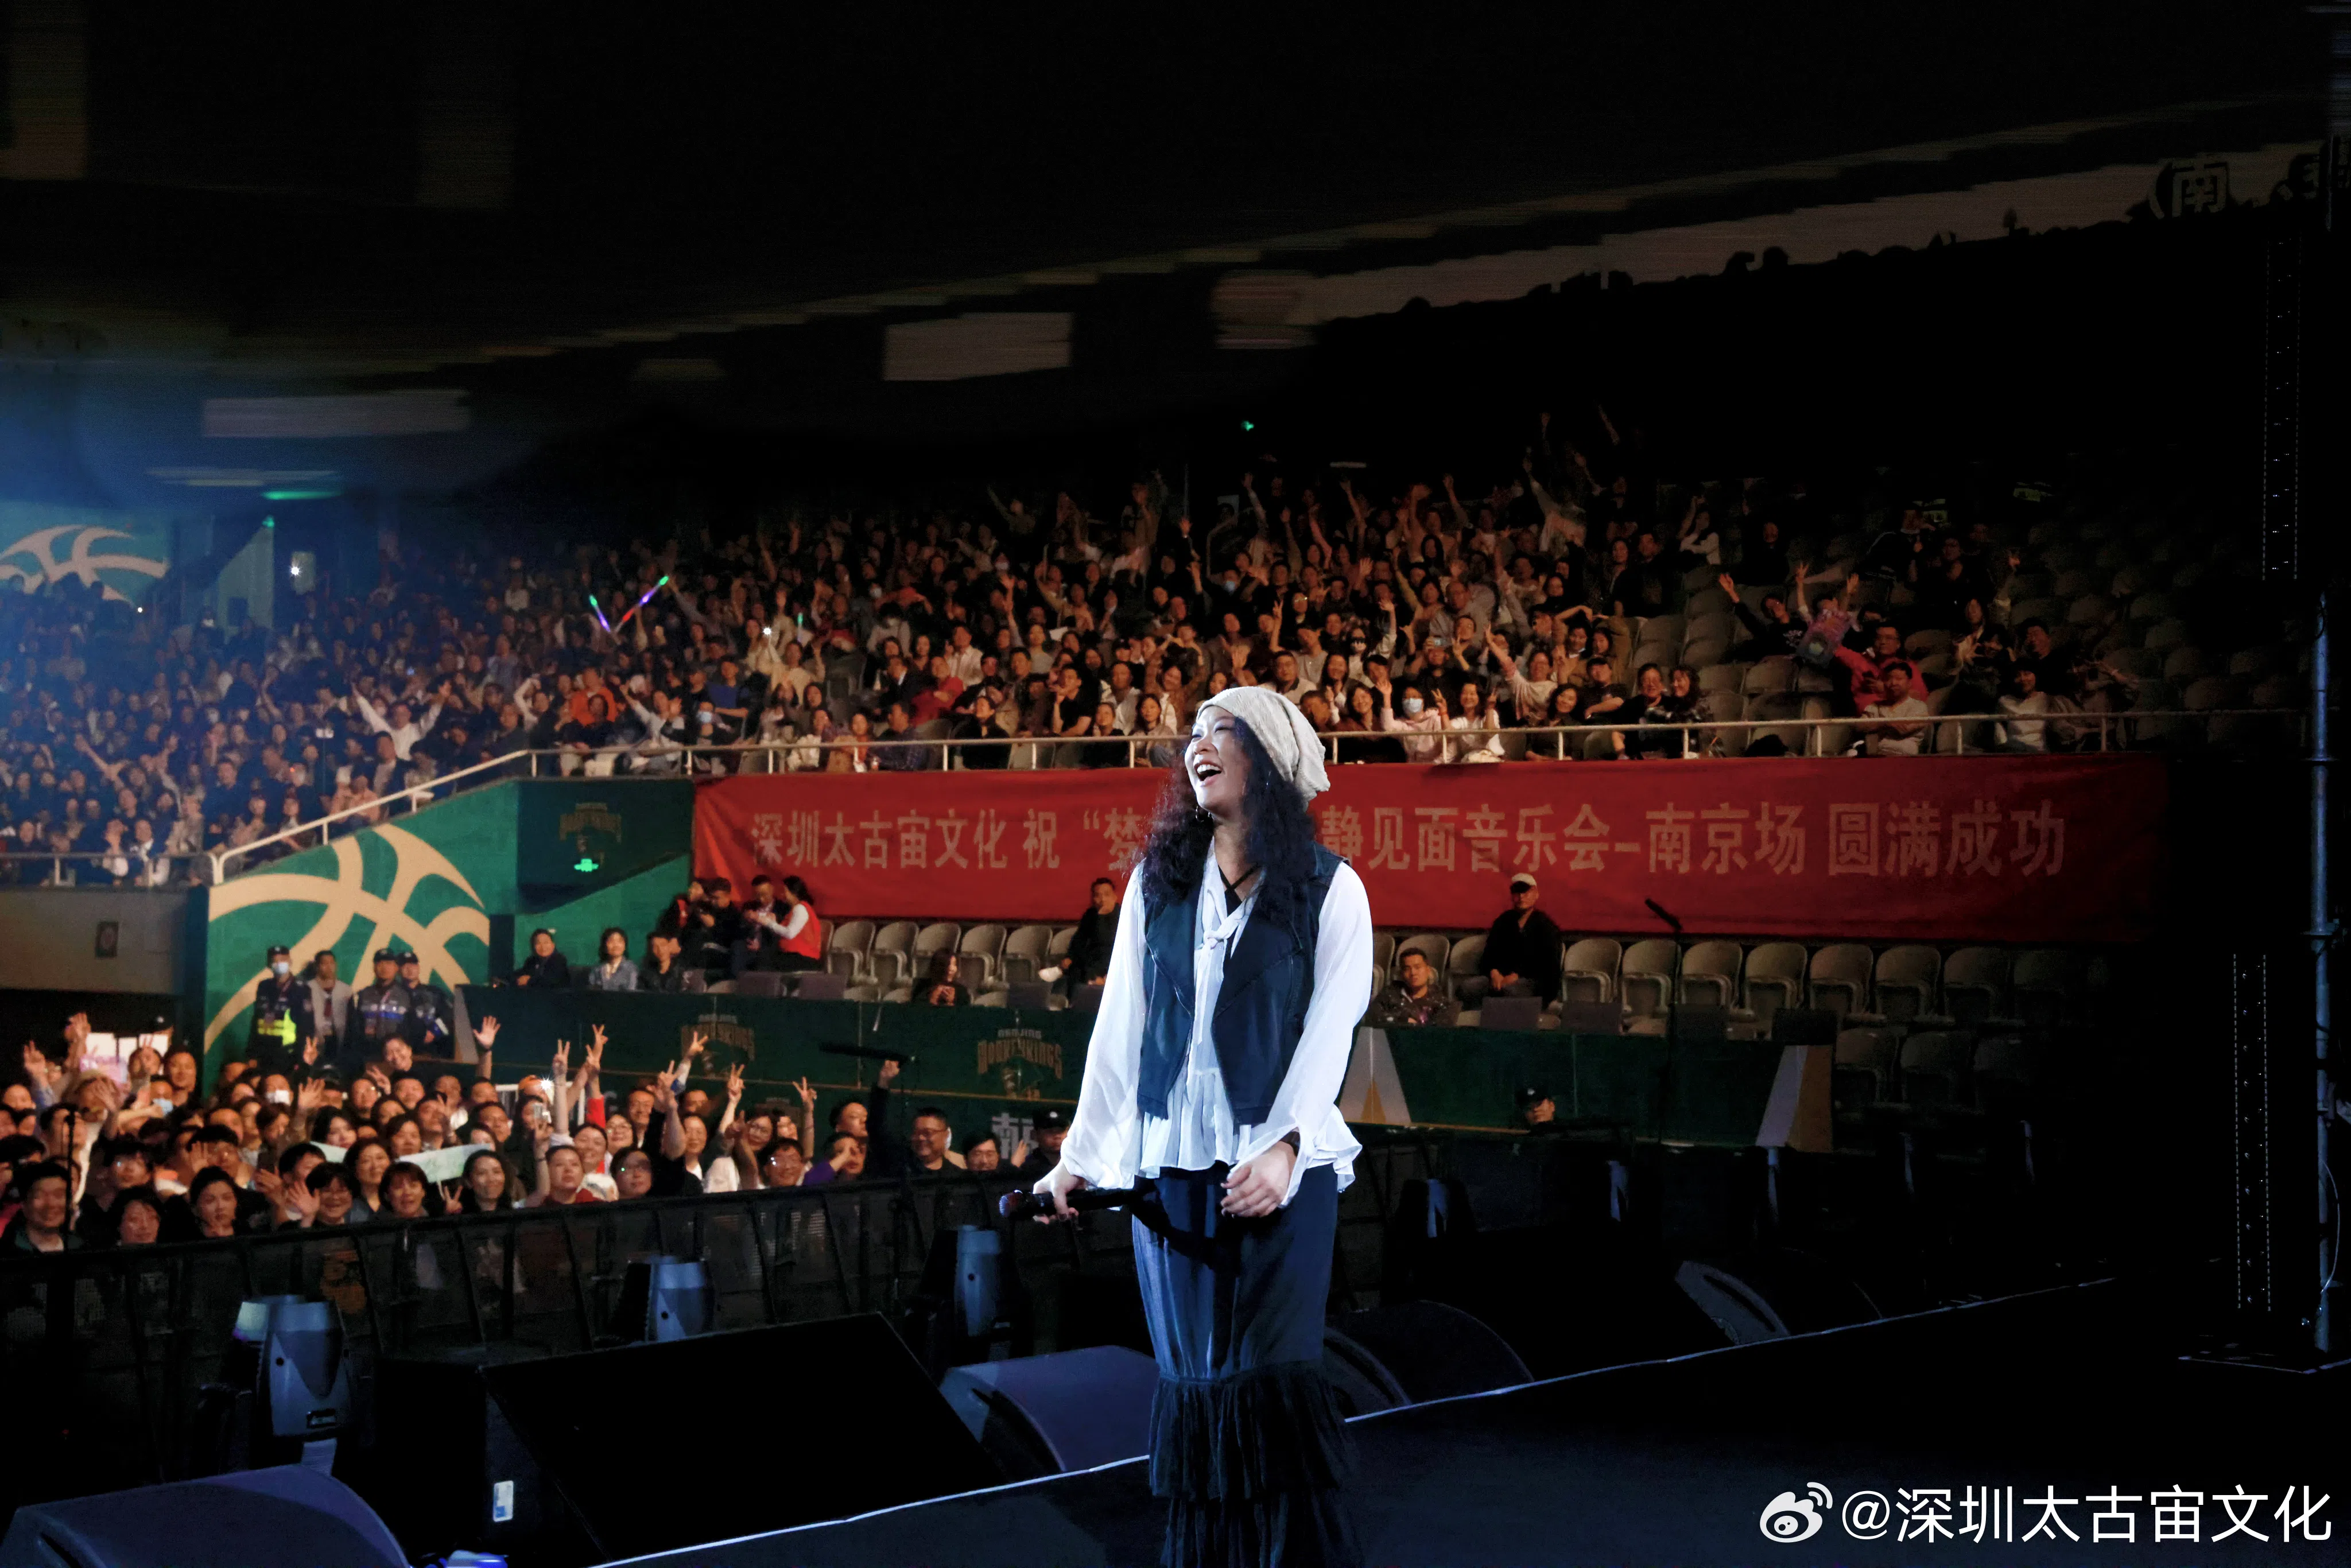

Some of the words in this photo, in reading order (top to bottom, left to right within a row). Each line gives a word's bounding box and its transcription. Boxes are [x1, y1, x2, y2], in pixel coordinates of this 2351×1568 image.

[751, 808, 1008, 870] 深圳太古宙文化
[1022, 808, 1060, 869] 祝
[1828, 799, 2066, 877] 圆满成功
